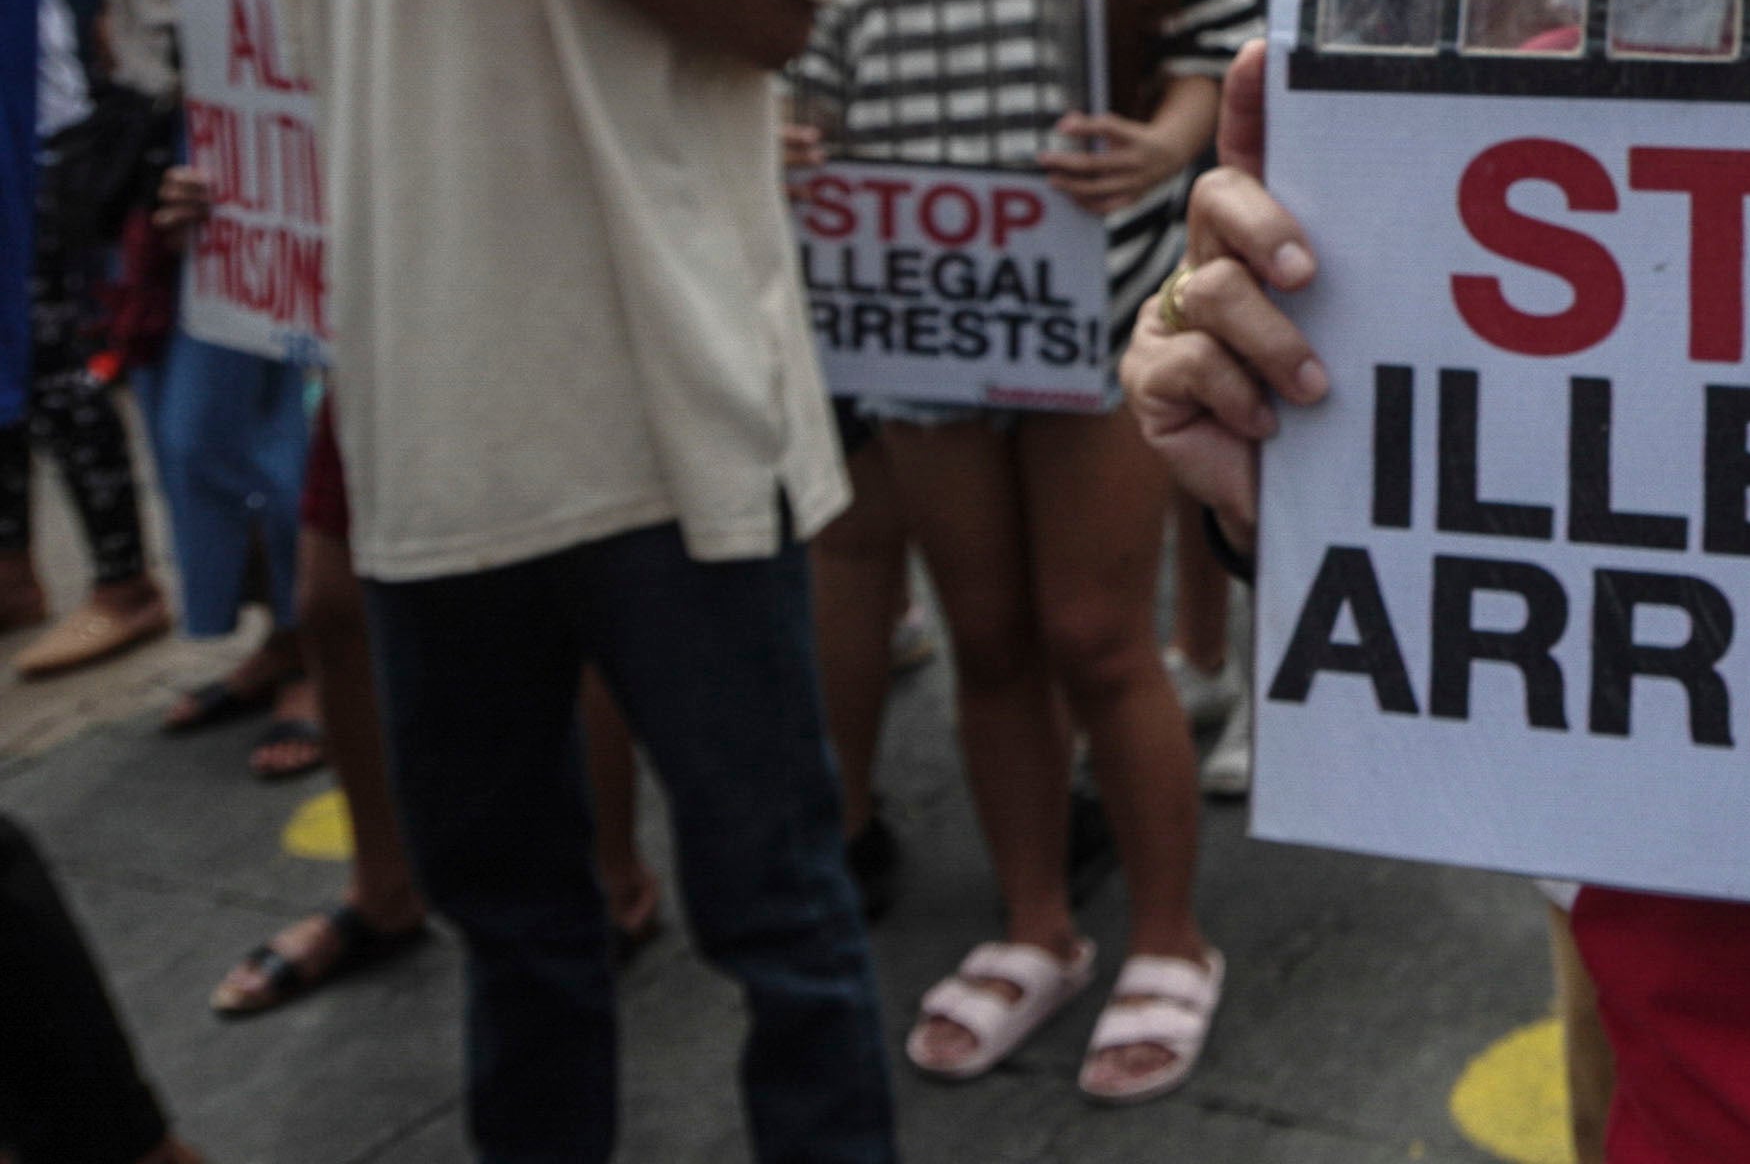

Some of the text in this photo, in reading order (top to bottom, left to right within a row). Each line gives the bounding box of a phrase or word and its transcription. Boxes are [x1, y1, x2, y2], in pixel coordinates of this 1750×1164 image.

[804, 174, 1046, 250] STOP
[801, 242, 1073, 309] LLEGAL
[810, 299, 1102, 367] RRESTS!
